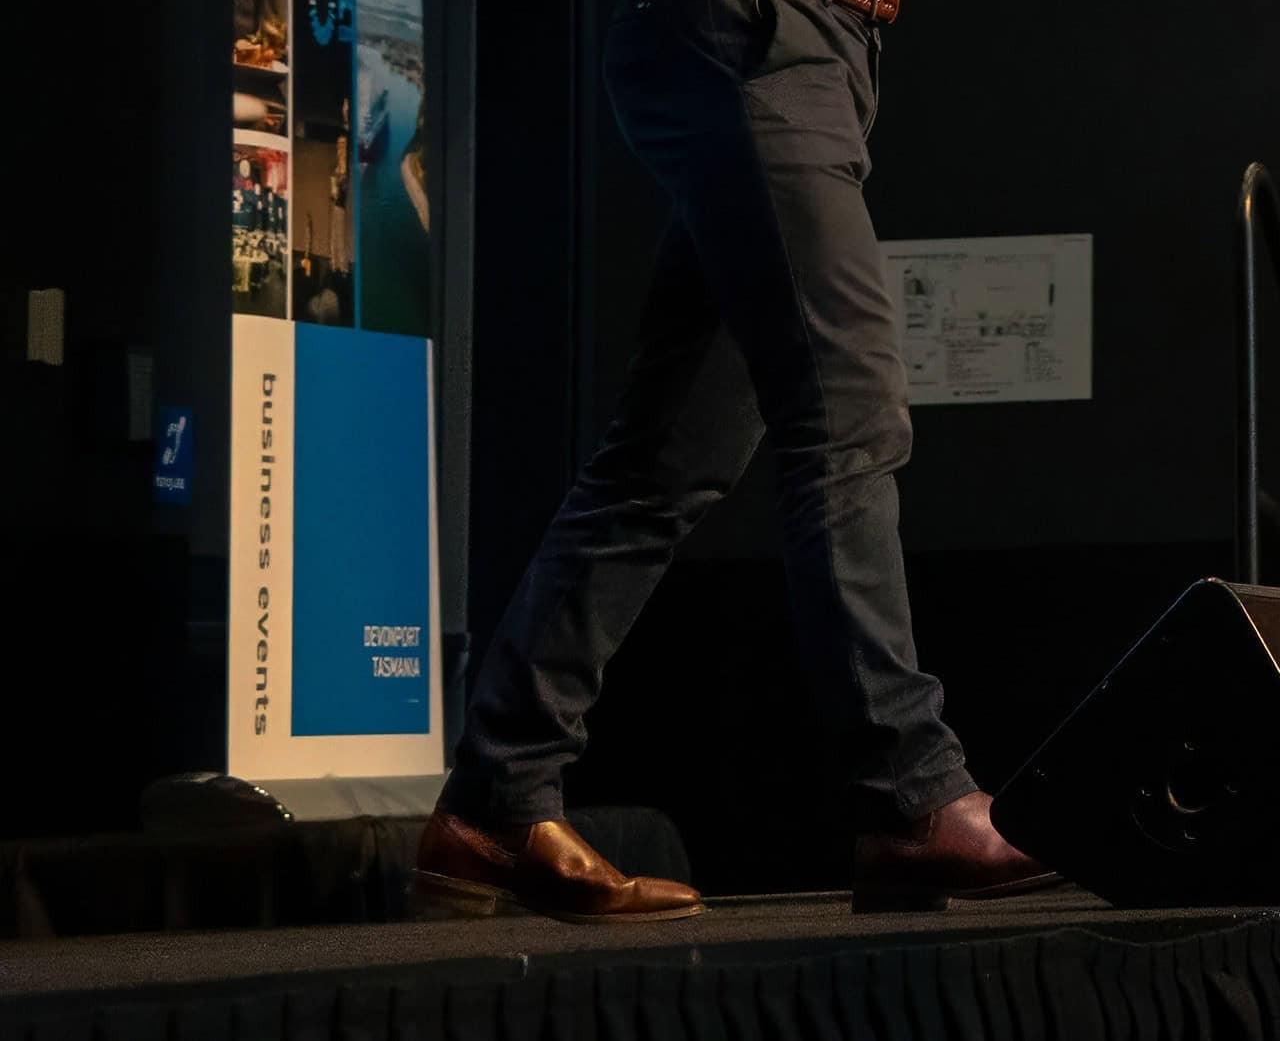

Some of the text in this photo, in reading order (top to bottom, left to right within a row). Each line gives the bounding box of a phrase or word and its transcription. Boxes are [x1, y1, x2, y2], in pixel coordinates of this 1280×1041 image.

[254, 373, 277, 736] business events
[363, 625, 421, 647] DEVONPORT
[372, 656, 421, 678] TASMANIA
